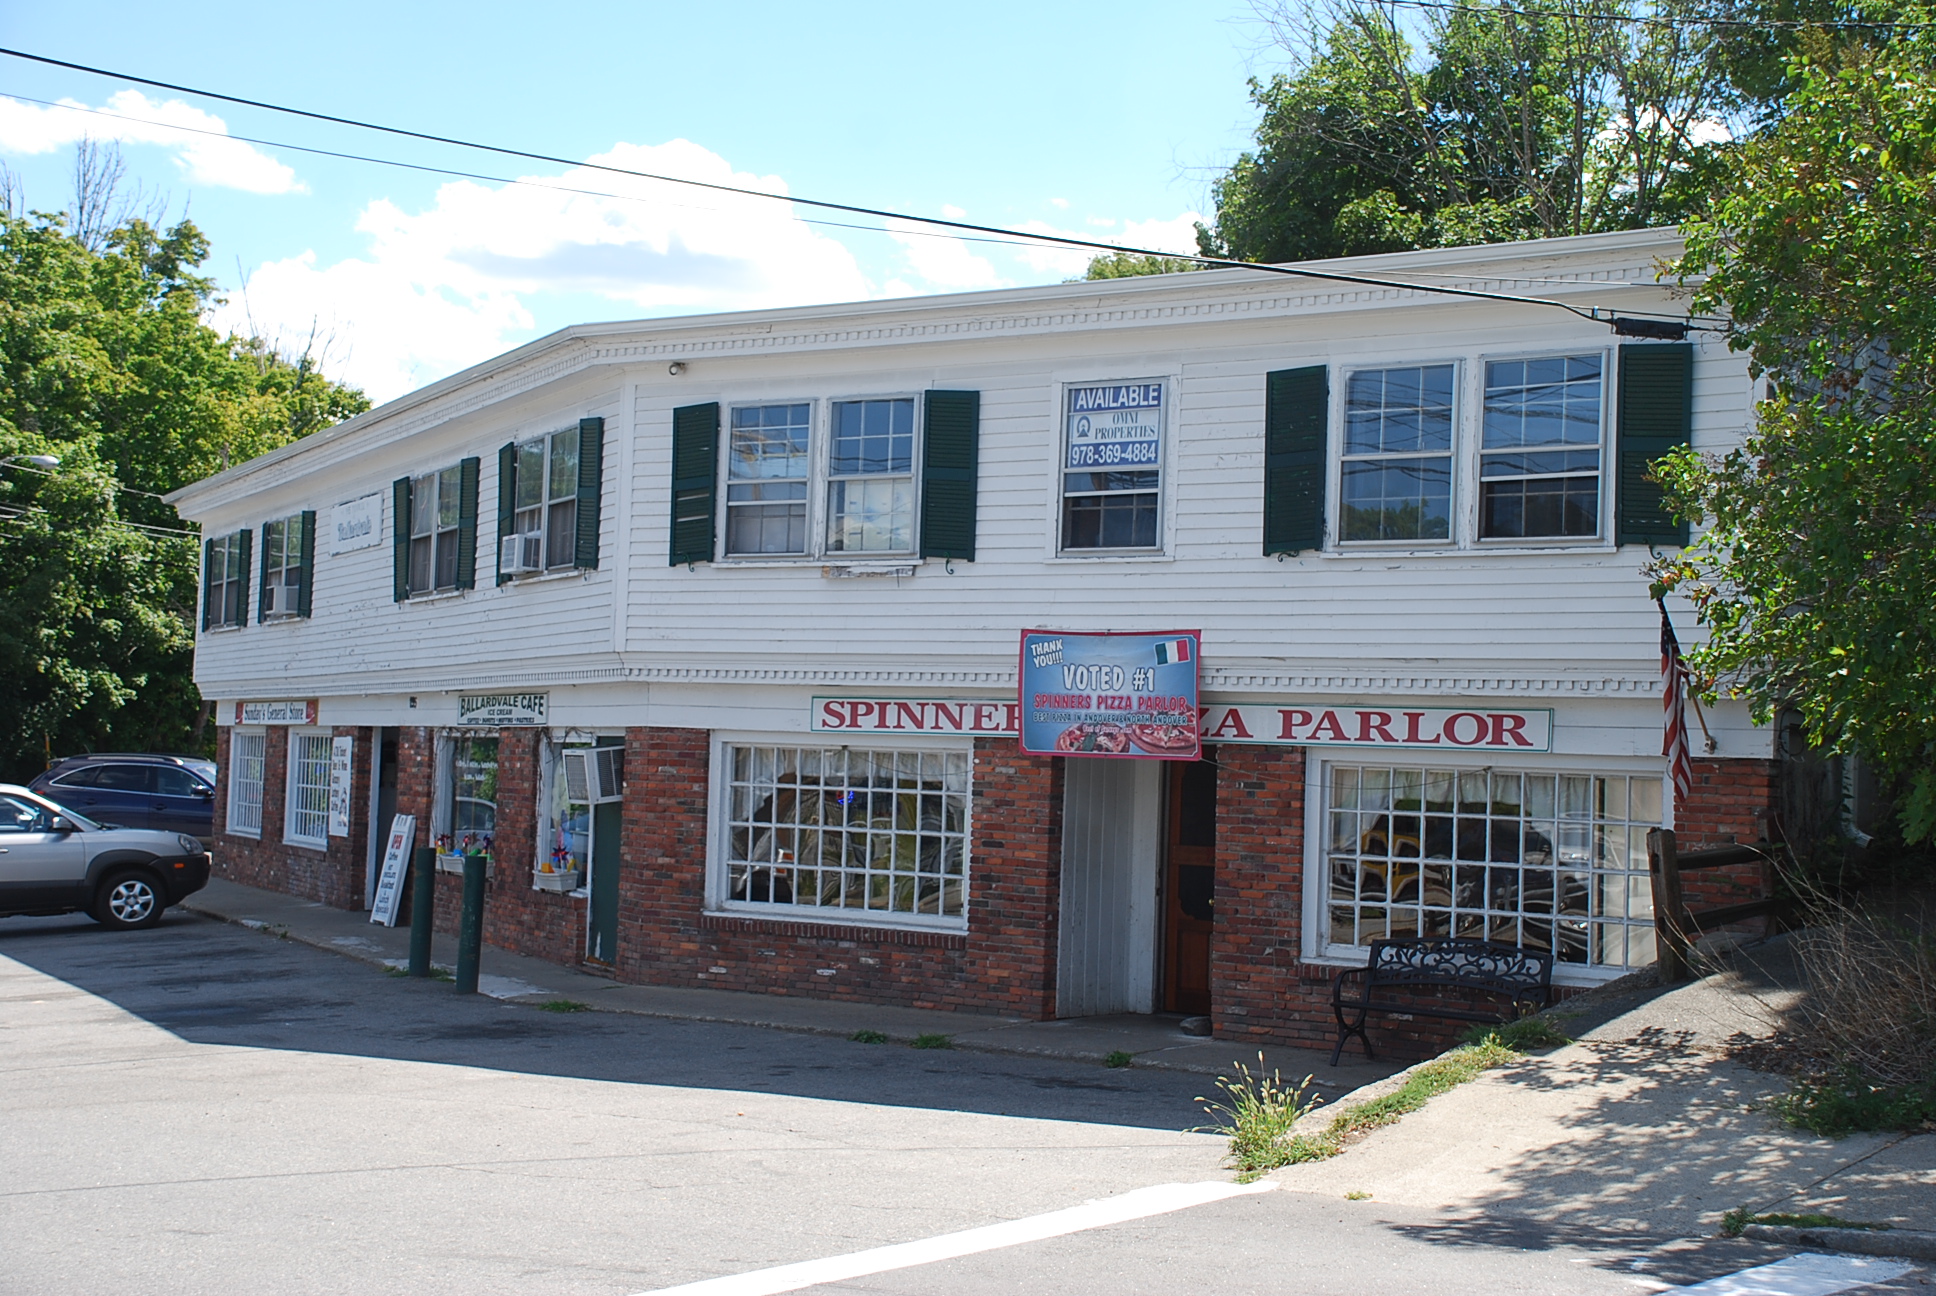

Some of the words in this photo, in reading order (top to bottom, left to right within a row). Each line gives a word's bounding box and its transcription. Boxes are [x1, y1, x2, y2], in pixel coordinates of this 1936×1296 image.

[1076, 386, 1158, 409] AVAILABLE
[1112, 411, 1139, 425] OMNI
[1094, 425, 1155, 440] PROPERTIES
[1072, 442, 1156, 465] 978-369-4884
[1031, 639, 1064, 656] THANK
[1033, 651, 1064, 668] YOU!!!
[1062, 664, 1125, 691] VOTED
[1132, 667, 1155, 691] #1
[267, 702, 287, 720] General
[289, 702, 304, 720] Store
[460, 696, 518, 718] BALLARDVALE
[521, 695, 544, 716] CAFE
[1033, 693, 1091, 710] SPINNERS
[1097, 695, 1132, 711] PIZZA
[1138, 696, 1187, 712] PARLOR
[1033, 711, 1050, 722] BEST
[1052, 711, 1071, 723] PIZZA
[1075, 712, 1081, 722] IN
[1084, 712, 1115, 723] ANDOVER
[1126, 714, 1150, 724] NORTH
[1153, 715, 1188, 725] ANDOVER
[1276, 708, 1534, 747] PARLOR
